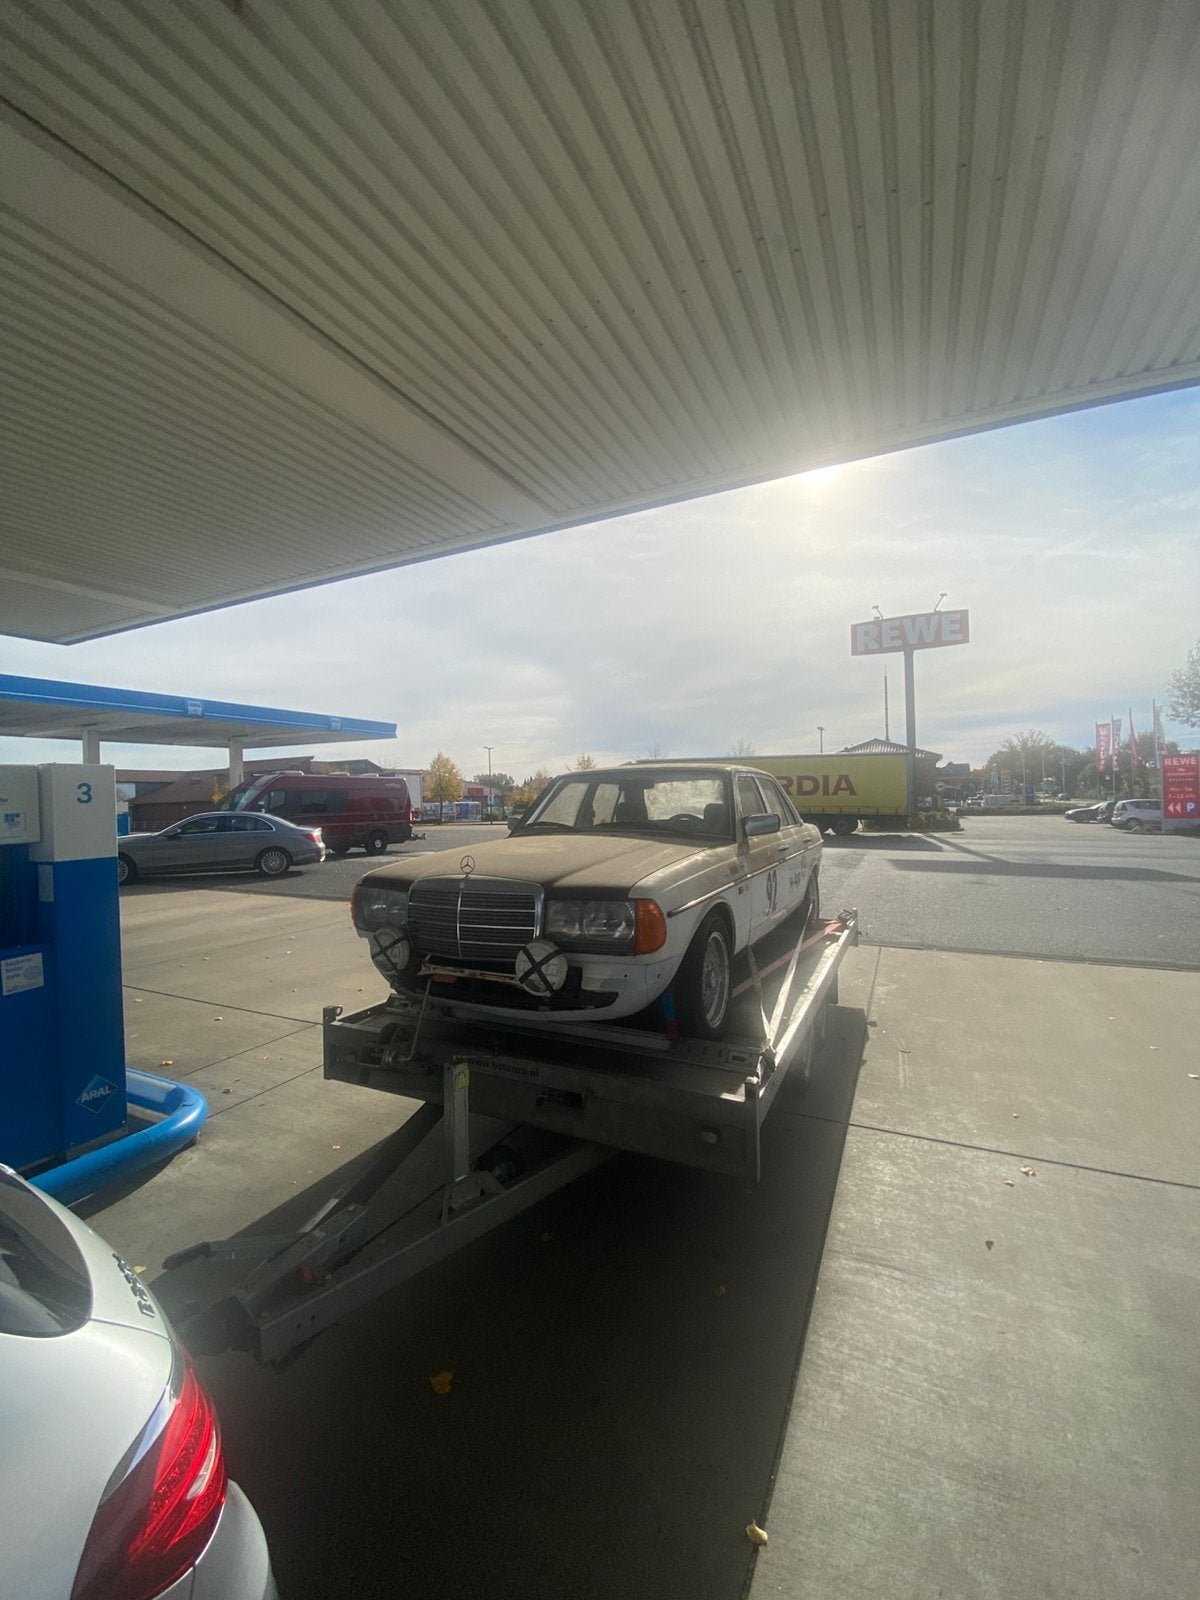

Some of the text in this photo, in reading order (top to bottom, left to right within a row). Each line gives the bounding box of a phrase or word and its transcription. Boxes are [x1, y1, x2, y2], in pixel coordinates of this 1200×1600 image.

[856, 613, 964, 652] REWE
[1164, 757, 1197, 766] REWE
[77, 782, 93, 804] 3
[1186, 802, 1196, 812] P
[80, 1084, 113, 1104] ARAL
